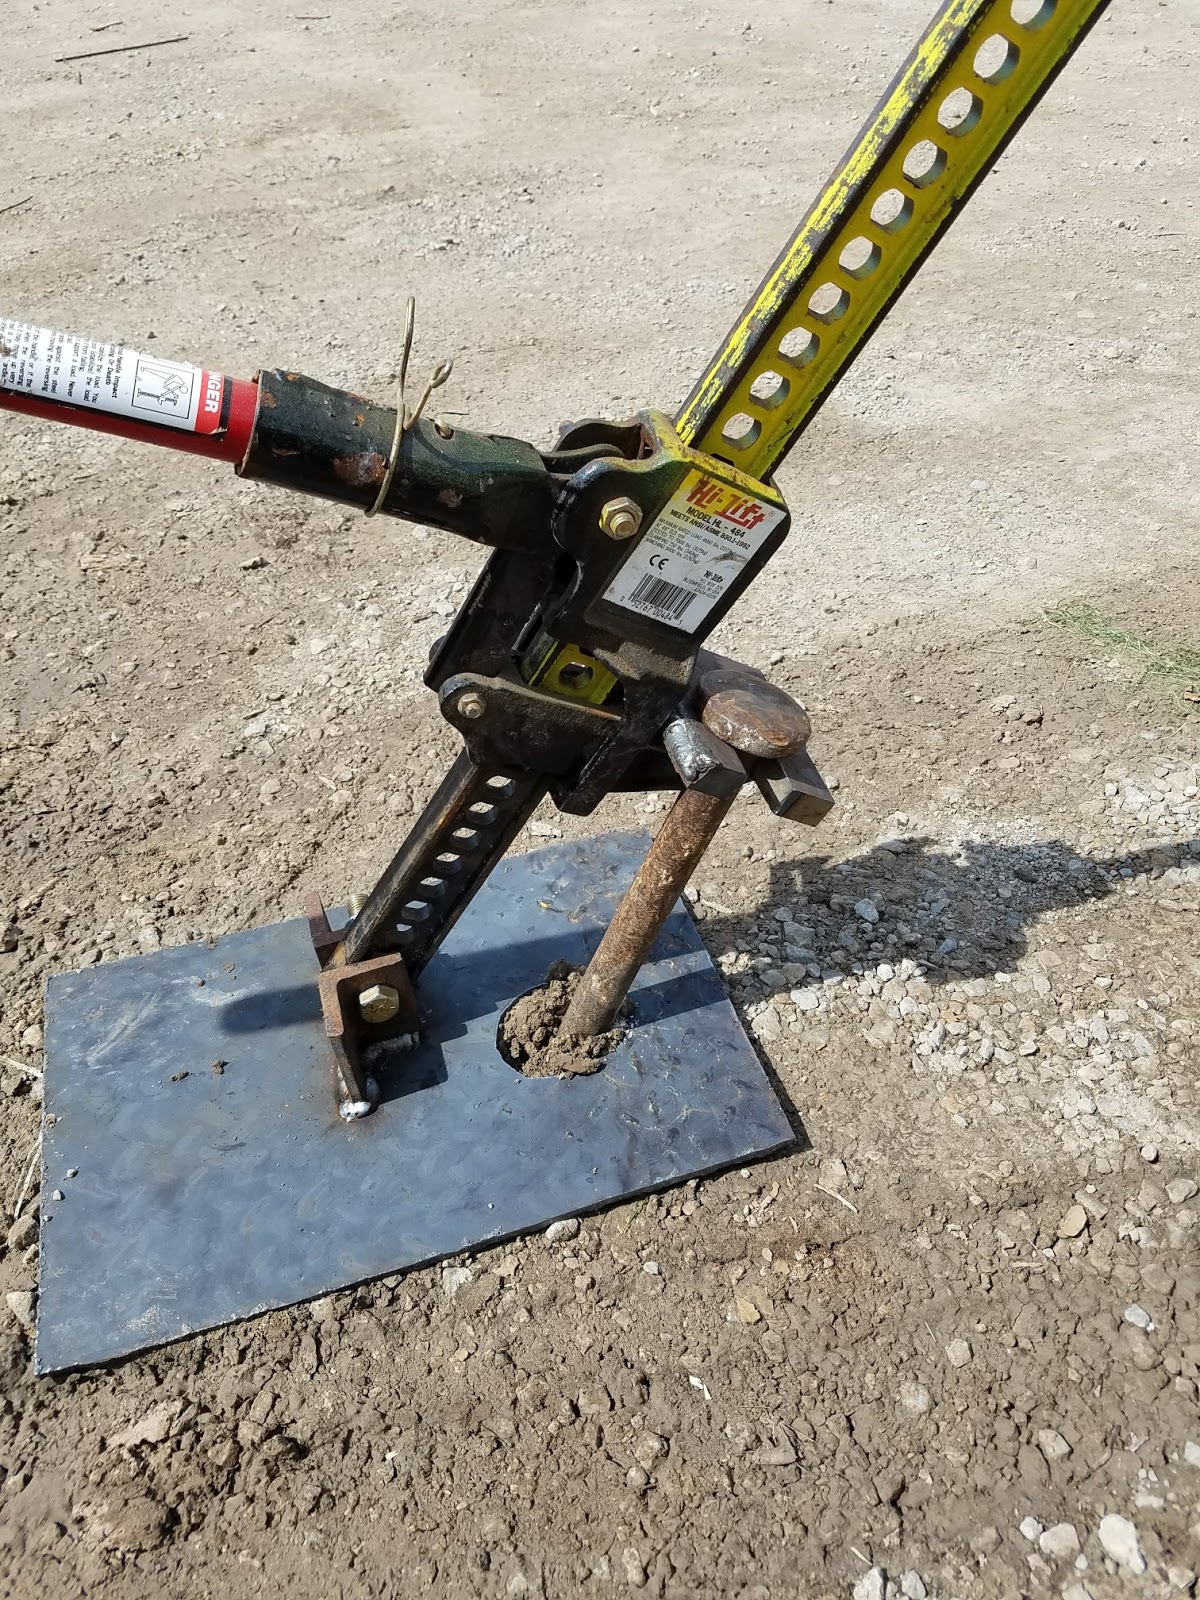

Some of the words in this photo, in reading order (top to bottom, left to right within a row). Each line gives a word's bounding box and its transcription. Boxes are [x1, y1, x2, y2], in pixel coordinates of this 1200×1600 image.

[17, 360, 26, 386] reversing
[116, 356, 124, 373] Handle
[41, 365, 51, 392] reversing
[105, 367, 114, 385] Death
[84, 390, 92, 402] load
[112, 376, 121, 398] Impact
[204, 371, 221, 413] NGER
[686, 478, 765, 530] Hi-Lift
[651, 527, 668, 537] TESTED
[669, 509, 689, 522] MEETS
[689, 518, 721, 536] ANSI/ASME
[719, 532, 750, 550] B30.1-1992
[685, 506, 712, 523] MODEL
[711, 518, 724, 528] HL
[729, 526, 745, 538] 484
[647, 532, 668, 544] CLAMPING
[677, 526, 690, 535] RATED
[690, 532, 702, 540] LOAD
[631, 600, 653, 614] 52767
[652, 607, 673, 621] 00484
